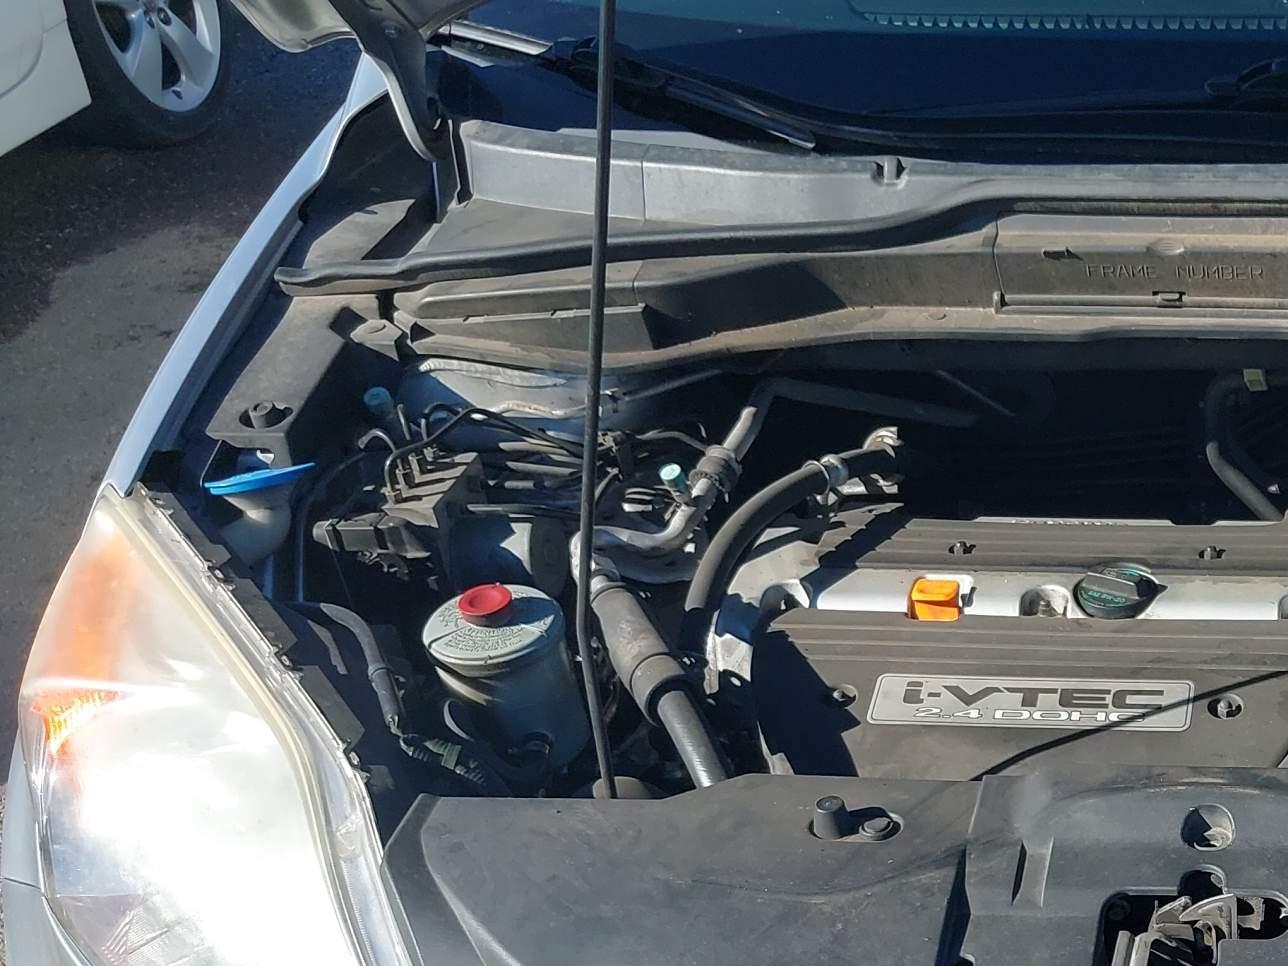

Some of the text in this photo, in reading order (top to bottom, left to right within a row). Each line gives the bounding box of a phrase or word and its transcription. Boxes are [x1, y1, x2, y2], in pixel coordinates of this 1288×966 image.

[1086, 263, 1264, 281] FRAME NUMBER
[902, 681, 1165, 709] i-VTEC
[914, 708, 1145, 722] 2.4 DOHC
